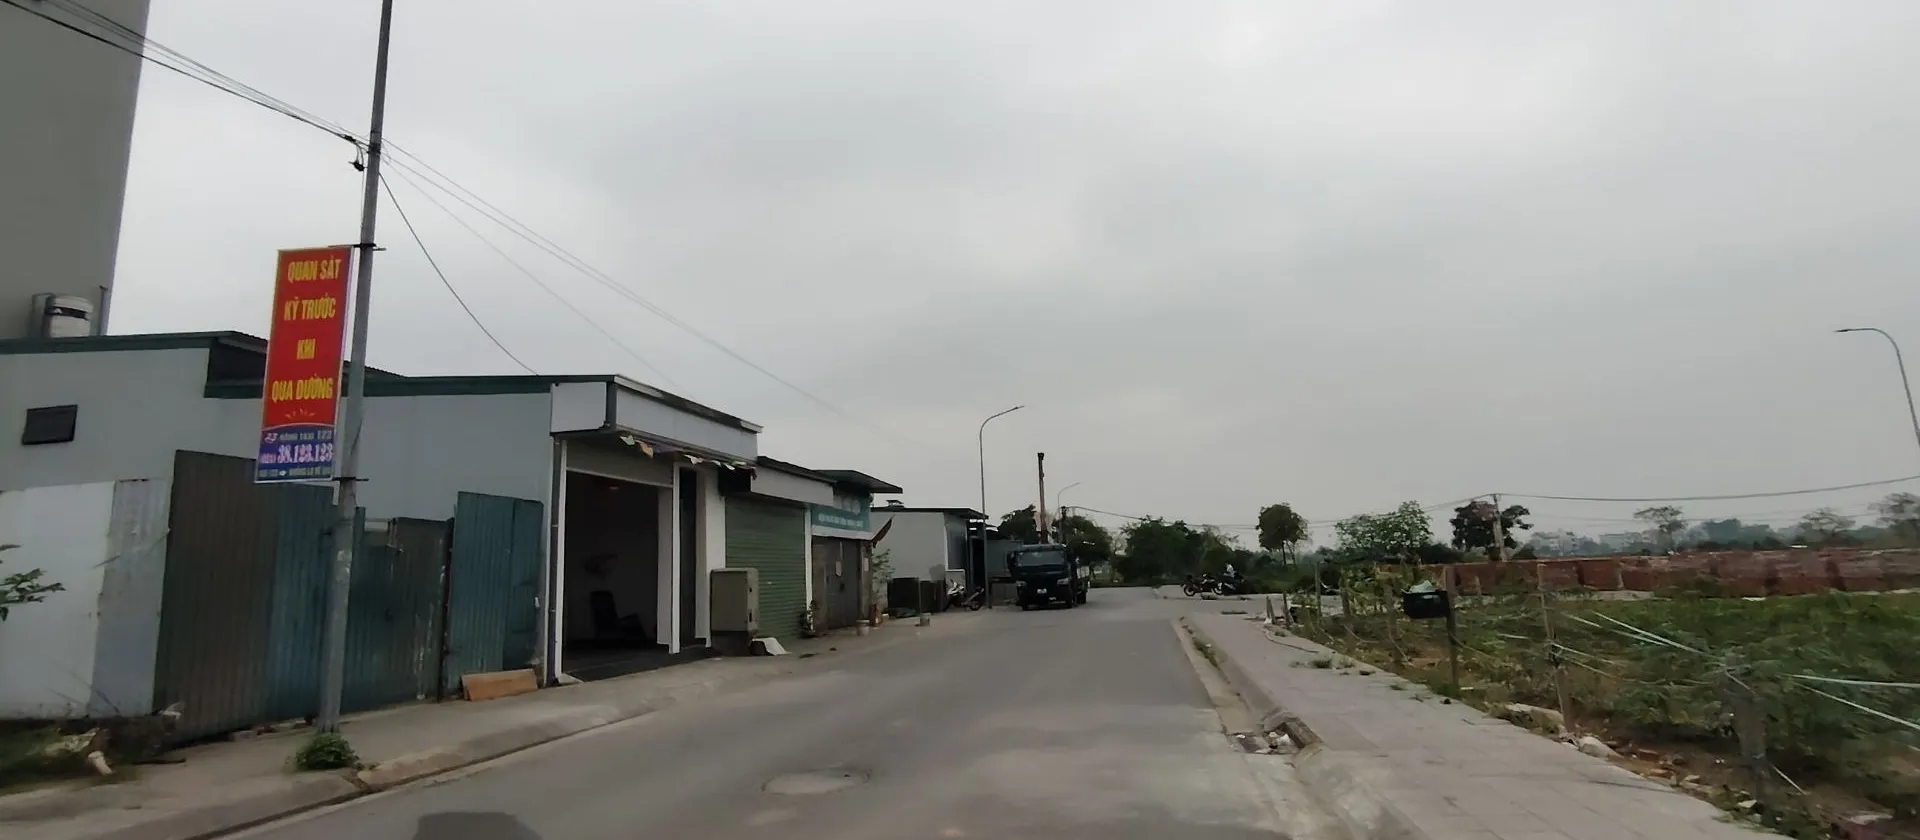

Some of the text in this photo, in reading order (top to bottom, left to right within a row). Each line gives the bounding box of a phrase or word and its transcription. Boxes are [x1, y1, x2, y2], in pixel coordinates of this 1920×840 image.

[288, 254, 341, 283] QUAN SÁT
[272, 380, 293, 404] QUA
